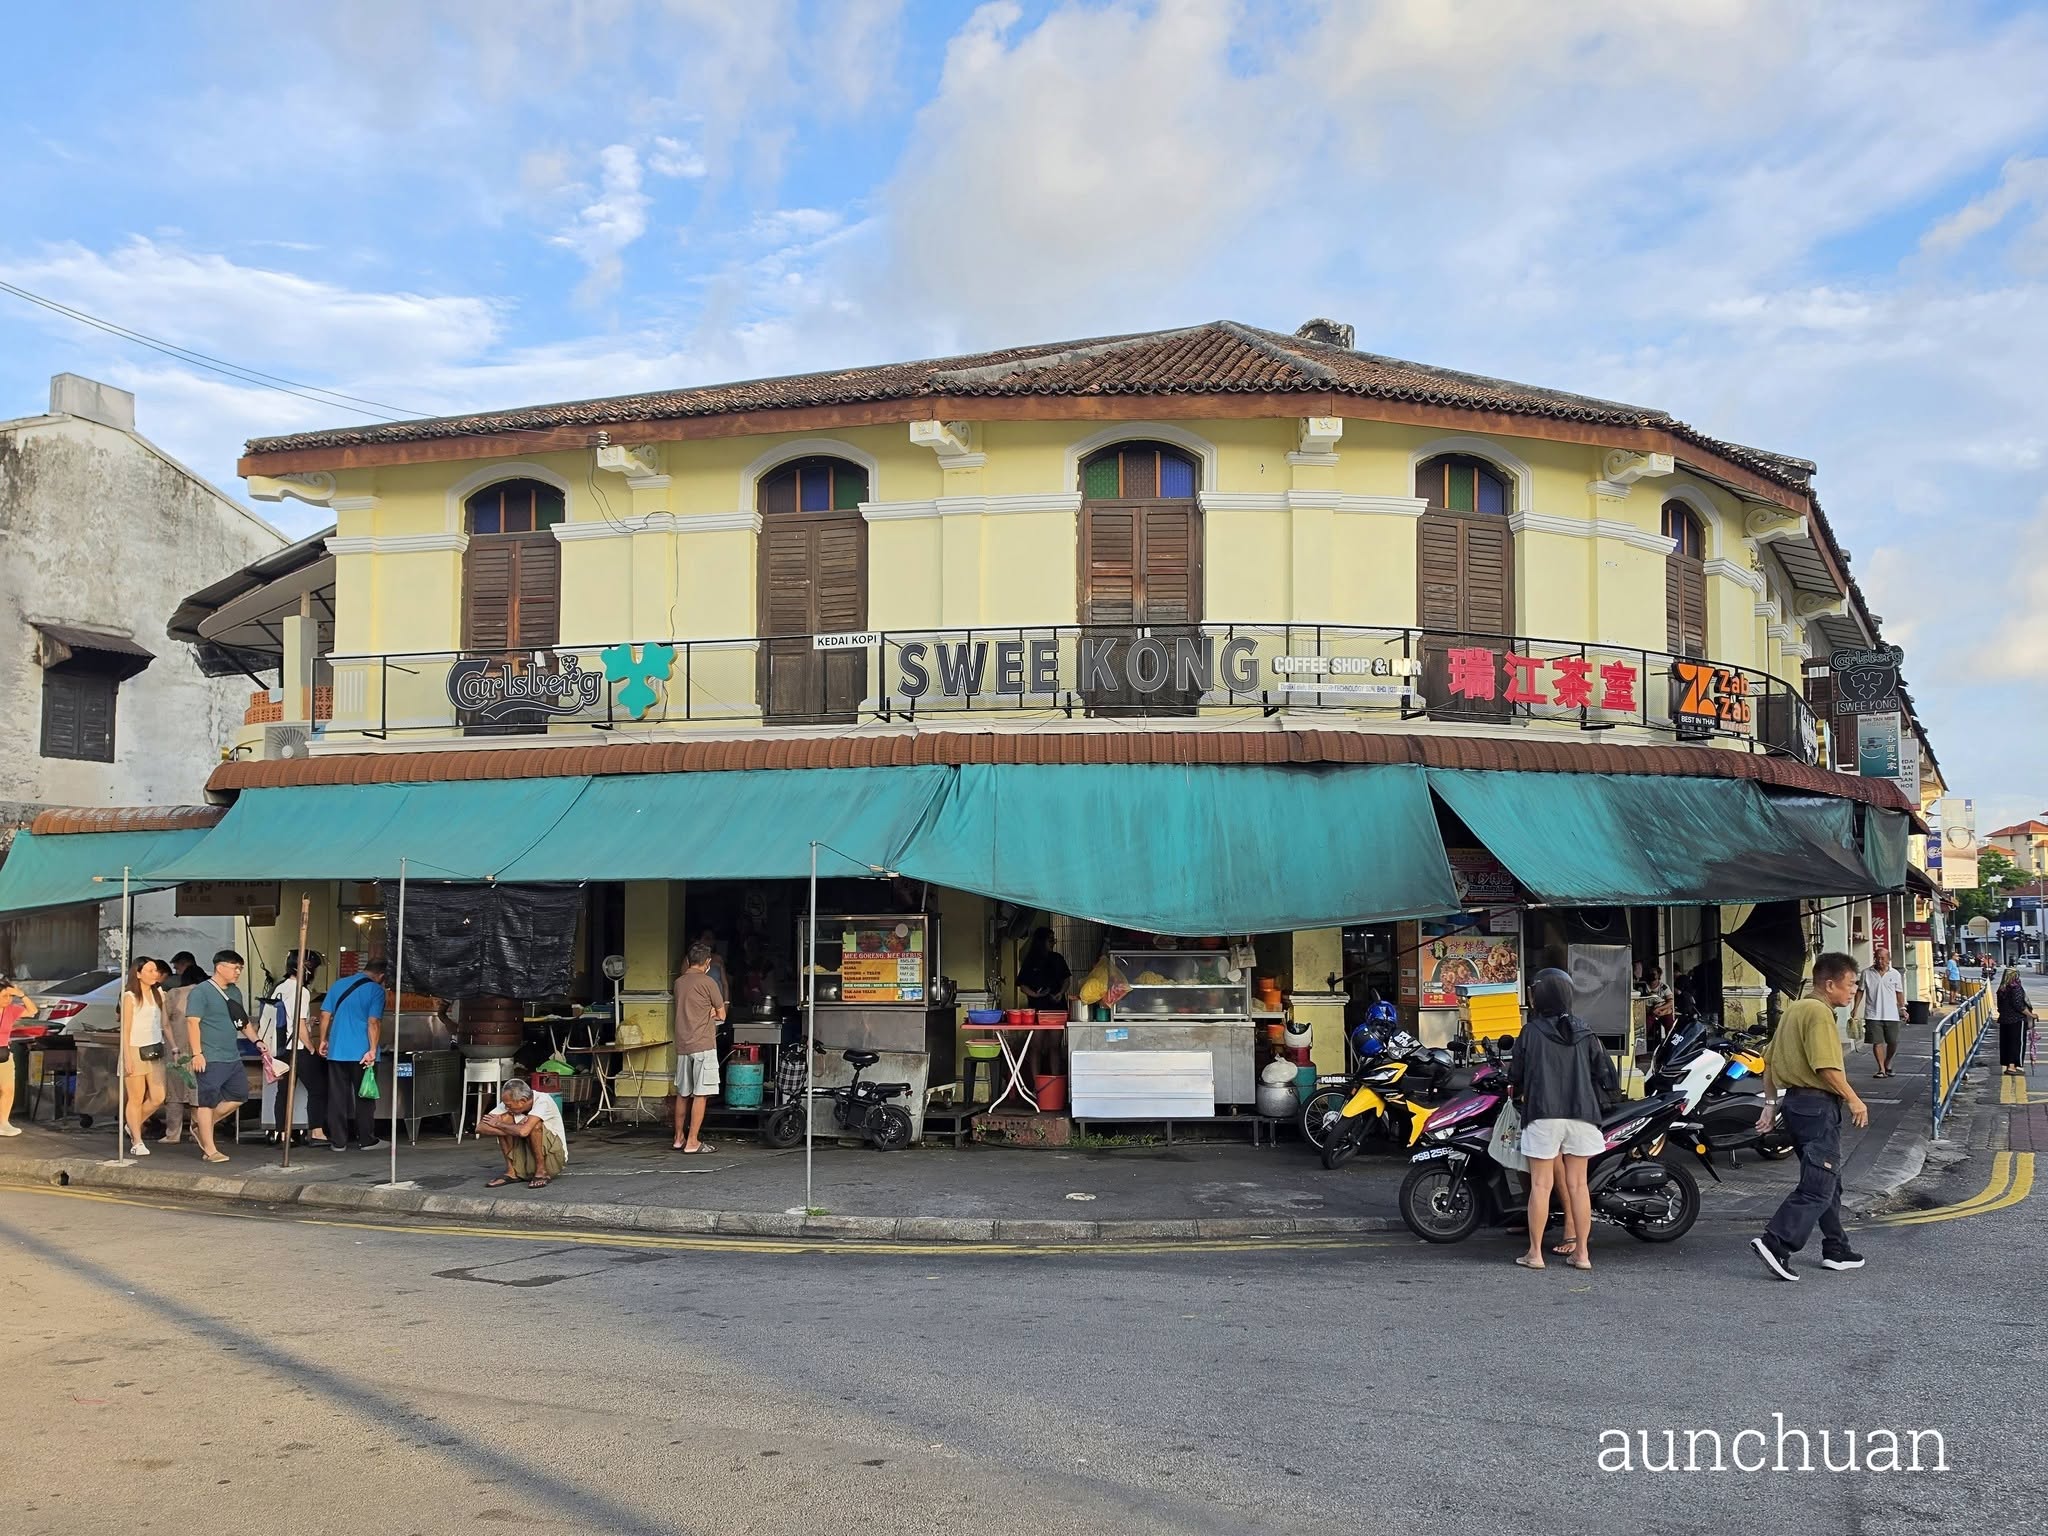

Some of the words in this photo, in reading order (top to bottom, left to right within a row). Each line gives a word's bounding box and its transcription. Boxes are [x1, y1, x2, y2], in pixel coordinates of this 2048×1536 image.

[818, 636, 849, 646] KEDAI
[851, 635, 878, 645] KOPI
[897, 640, 1060, 697] SWEE
[1081, 637, 1260, 693] KONG
[1272, 656, 1328, 674] COFFEE
[1330, 657, 1371, 675] SHOP
[1372, 657, 1388, 676] &
[1830, 646, 1904, 671] Carlsberg
[446, 655, 602, 720] Carlsberg
[1448, 648, 1637, 712] 瑞江茶室
[1717, 669, 1750, 696] Zab
[1717, 696, 1751, 722] Zab
[1839, 701, 1867, 712] SWEE
[1680, 715, 1695, 724] BEST
[1702, 718, 1716, 726] THAI
[1458, 1124, 1479, 1133] HONDA
[1412, 1151, 1430, 1163] PSB
